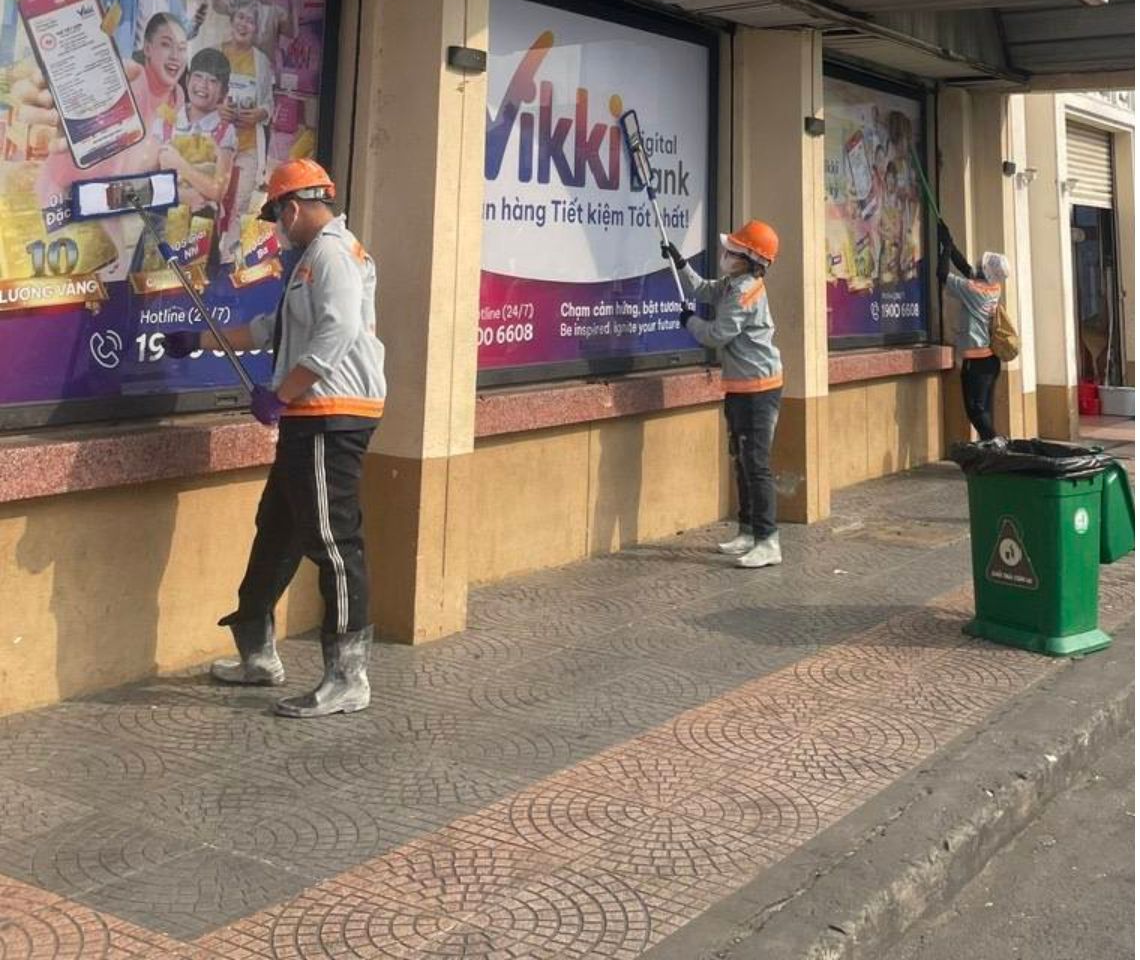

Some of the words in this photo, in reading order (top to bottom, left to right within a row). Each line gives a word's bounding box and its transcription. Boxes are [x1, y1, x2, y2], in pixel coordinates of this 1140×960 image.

[640, 130, 677, 157] igital
[501, 197, 546, 227] hàng
[551, 197, 583, 224] Tiết
[588, 200, 625, 231] kiệm
[628, 203, 651, 227] Tốt
[25, 238, 79, 278] 10
[140, 308, 186, 324] Hotline
[188, 306, 231, 324] (2/7)
[502, 302, 535, 321] (24/7)
[560, 301, 591, 321] Chạm
[593, 300, 614, 317] cảm
[496, 323, 534, 344] 6608
[560, 322, 573, 337] Be
